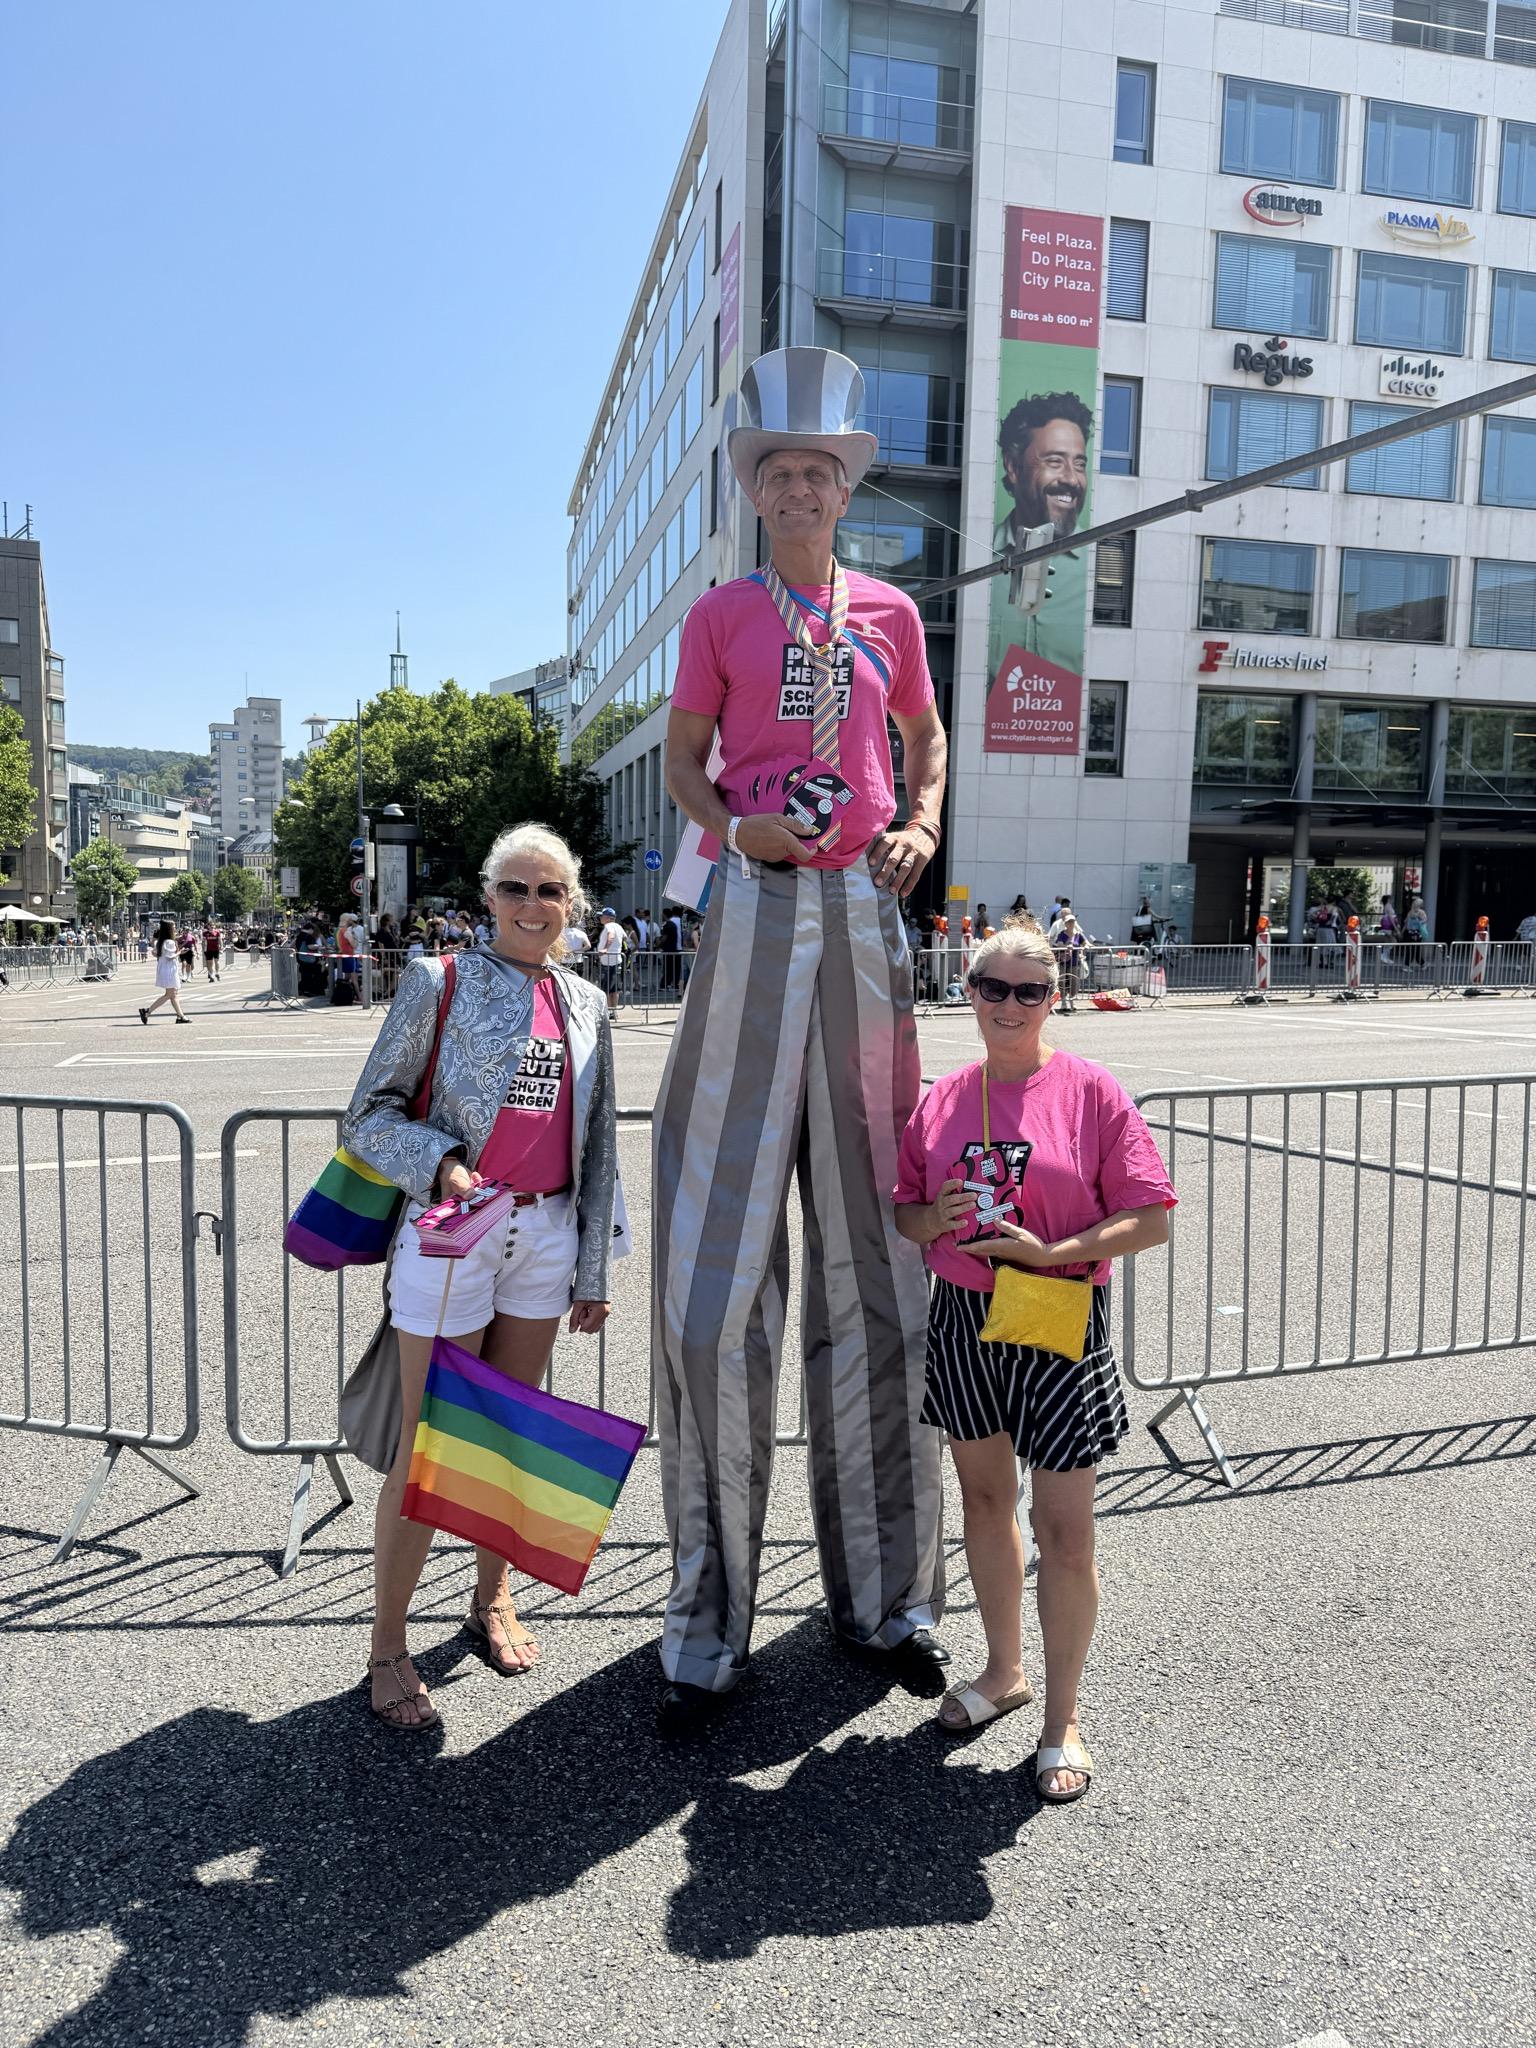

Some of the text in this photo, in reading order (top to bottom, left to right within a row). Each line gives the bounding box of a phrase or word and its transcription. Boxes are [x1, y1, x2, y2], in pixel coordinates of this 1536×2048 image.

[1255, 189, 1323, 216] auren
[1021, 229, 1097, 250] Feel Plaza.
[1031, 252, 1096, 271] Do Plaza.
[1022, 272, 1095, 292] City Plaza.
[1010, 309, 1039, 321] Büros
[1042, 313, 1054, 323] ab
[1057, 314, 1077, 325] 600
[1233, 342, 1314, 386] Regus
[785, 667, 850, 683] HEE
[1021, 674, 1057, 696] city
[783, 690, 847, 703] SCHZ
[1012, 693, 1063, 714] plaza
[781, 704, 845, 717] MORN
[991, 719, 1074, 732] 0711 20702700
[525, 1039, 564, 1060] RÜF
[518, 1059, 562, 1077] EUTE
[508, 1080, 557, 1095] CHÜTZ
[503, 1094, 554, 1108] ORGEN
